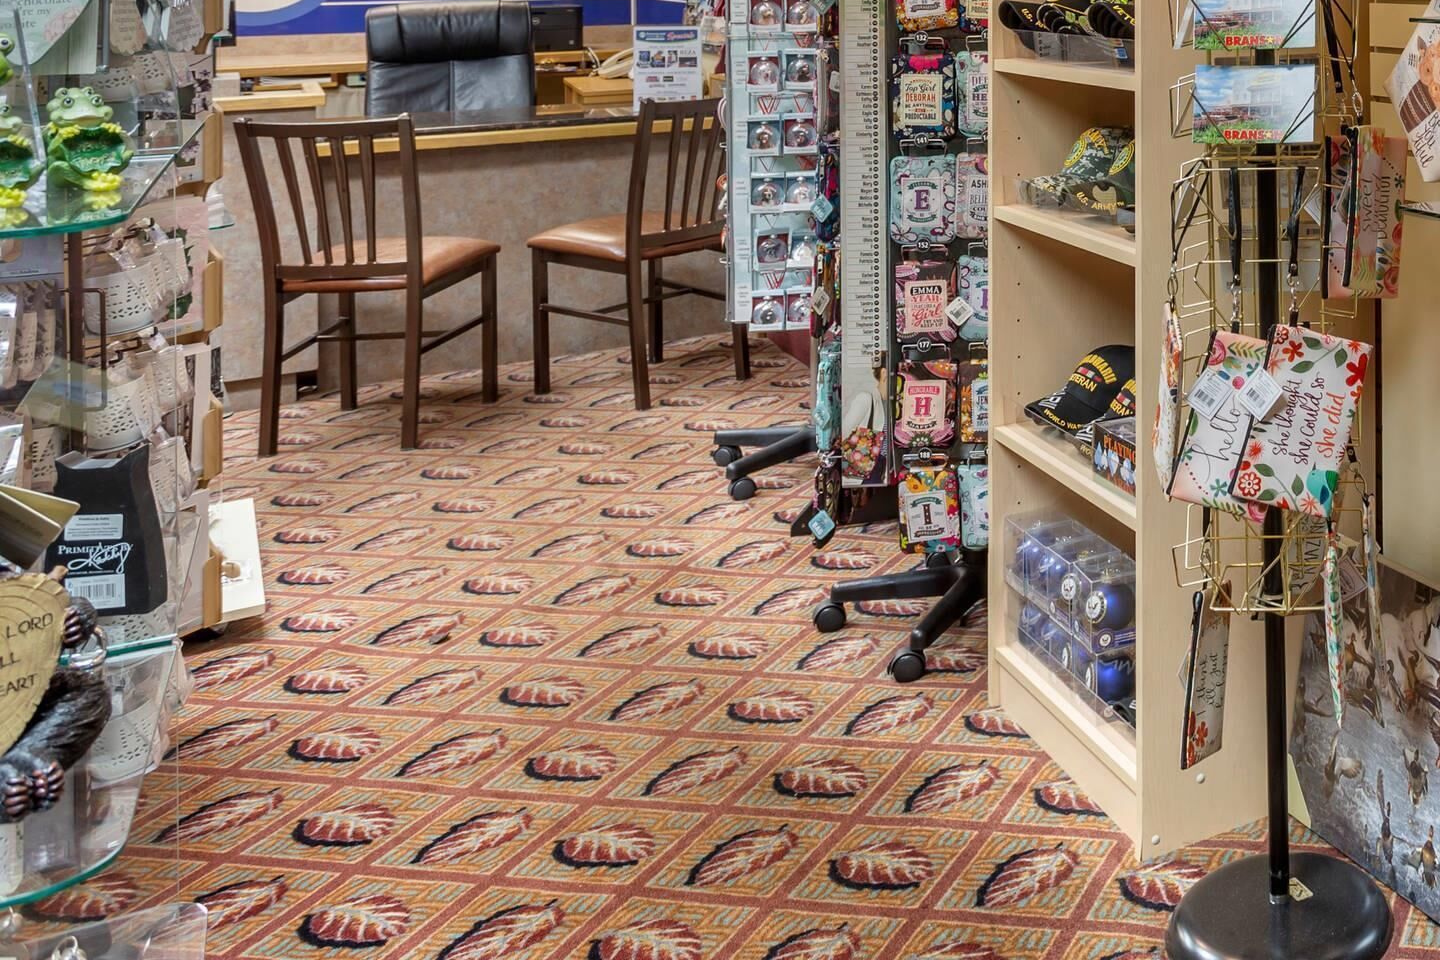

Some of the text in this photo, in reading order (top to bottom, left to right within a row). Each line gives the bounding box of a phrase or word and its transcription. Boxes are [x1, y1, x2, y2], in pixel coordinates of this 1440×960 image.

[905, 92, 936, 103] DEBORAH
[916, 136, 928, 144] 141
[913, 189, 931, 211] E
[1362, 178, 1374, 233] sweet
[917, 241, 929, 249] 152
[911, 286, 941, 295] EMMA
[910, 307, 943, 327] Girl
[918, 341, 930, 349] 177
[914, 396, 933, 417] H
[1273, 379, 1303, 432] thought
[1299, 391, 1323, 439] could
[1043, 408, 1066, 431] WORLD
[1314, 392, 1347, 458] she did
[922, 503, 933, 526] I
[5, 611, 54, 640] LORD
